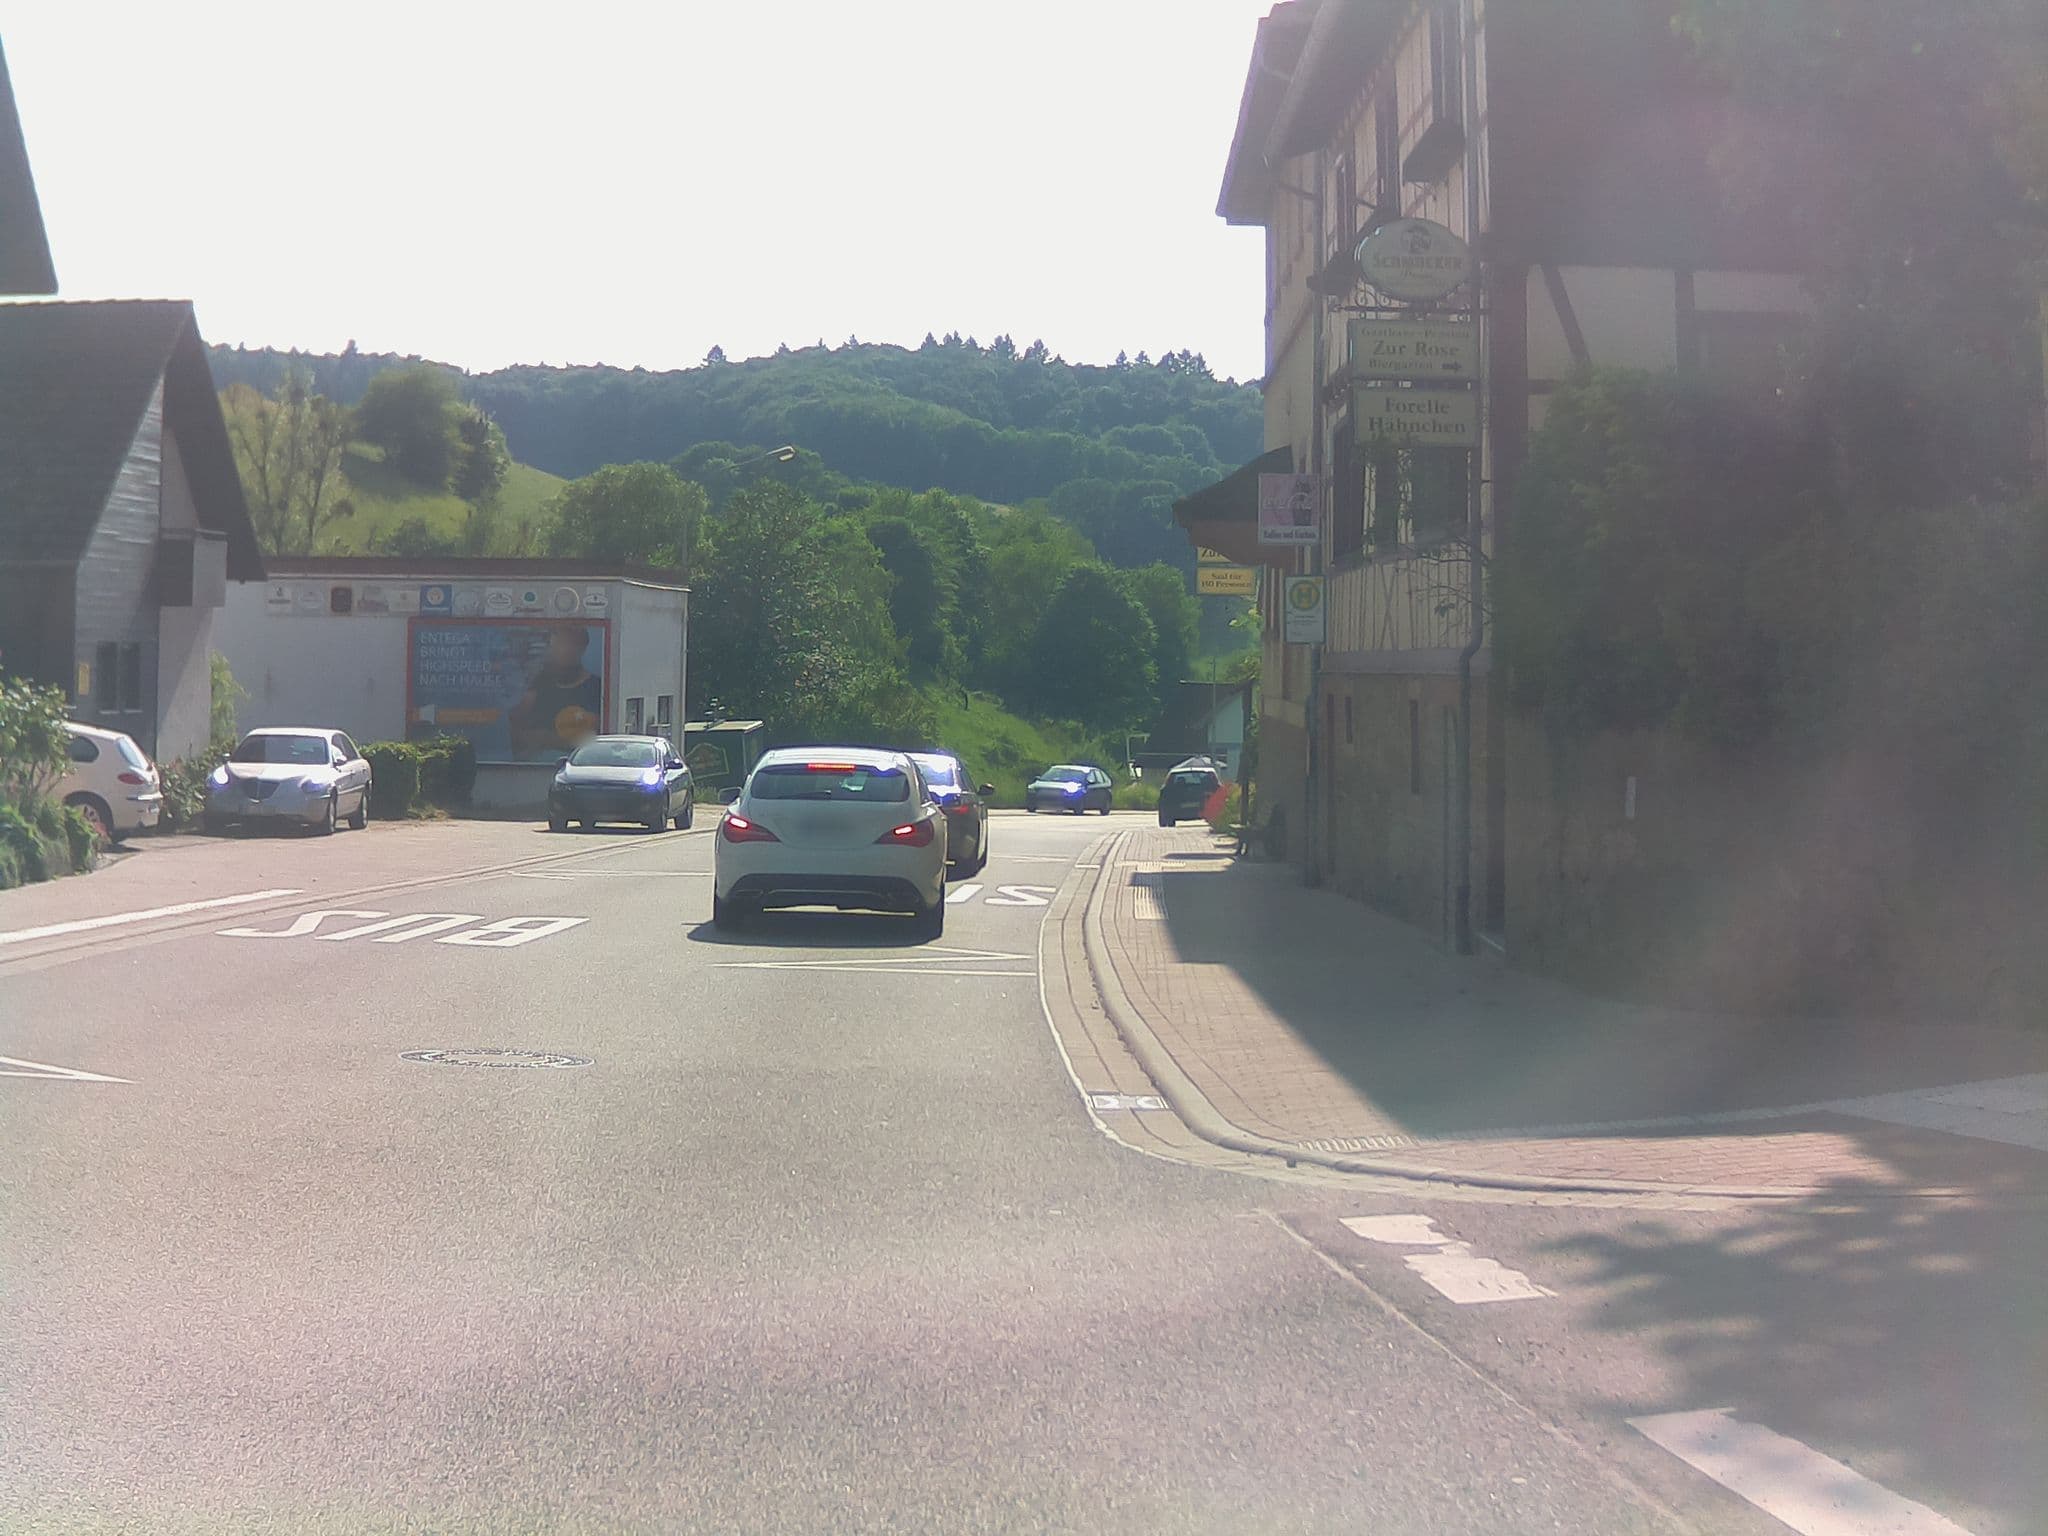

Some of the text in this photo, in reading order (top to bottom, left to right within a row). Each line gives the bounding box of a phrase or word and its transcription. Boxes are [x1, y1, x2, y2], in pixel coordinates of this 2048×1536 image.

[1373, 340, 1459, 357] Zur Rose
[1385, 397, 1450, 414] Forelle
[1368, 416, 1466, 433] Hähnchen
[215, 909, 591, 948] BUS
